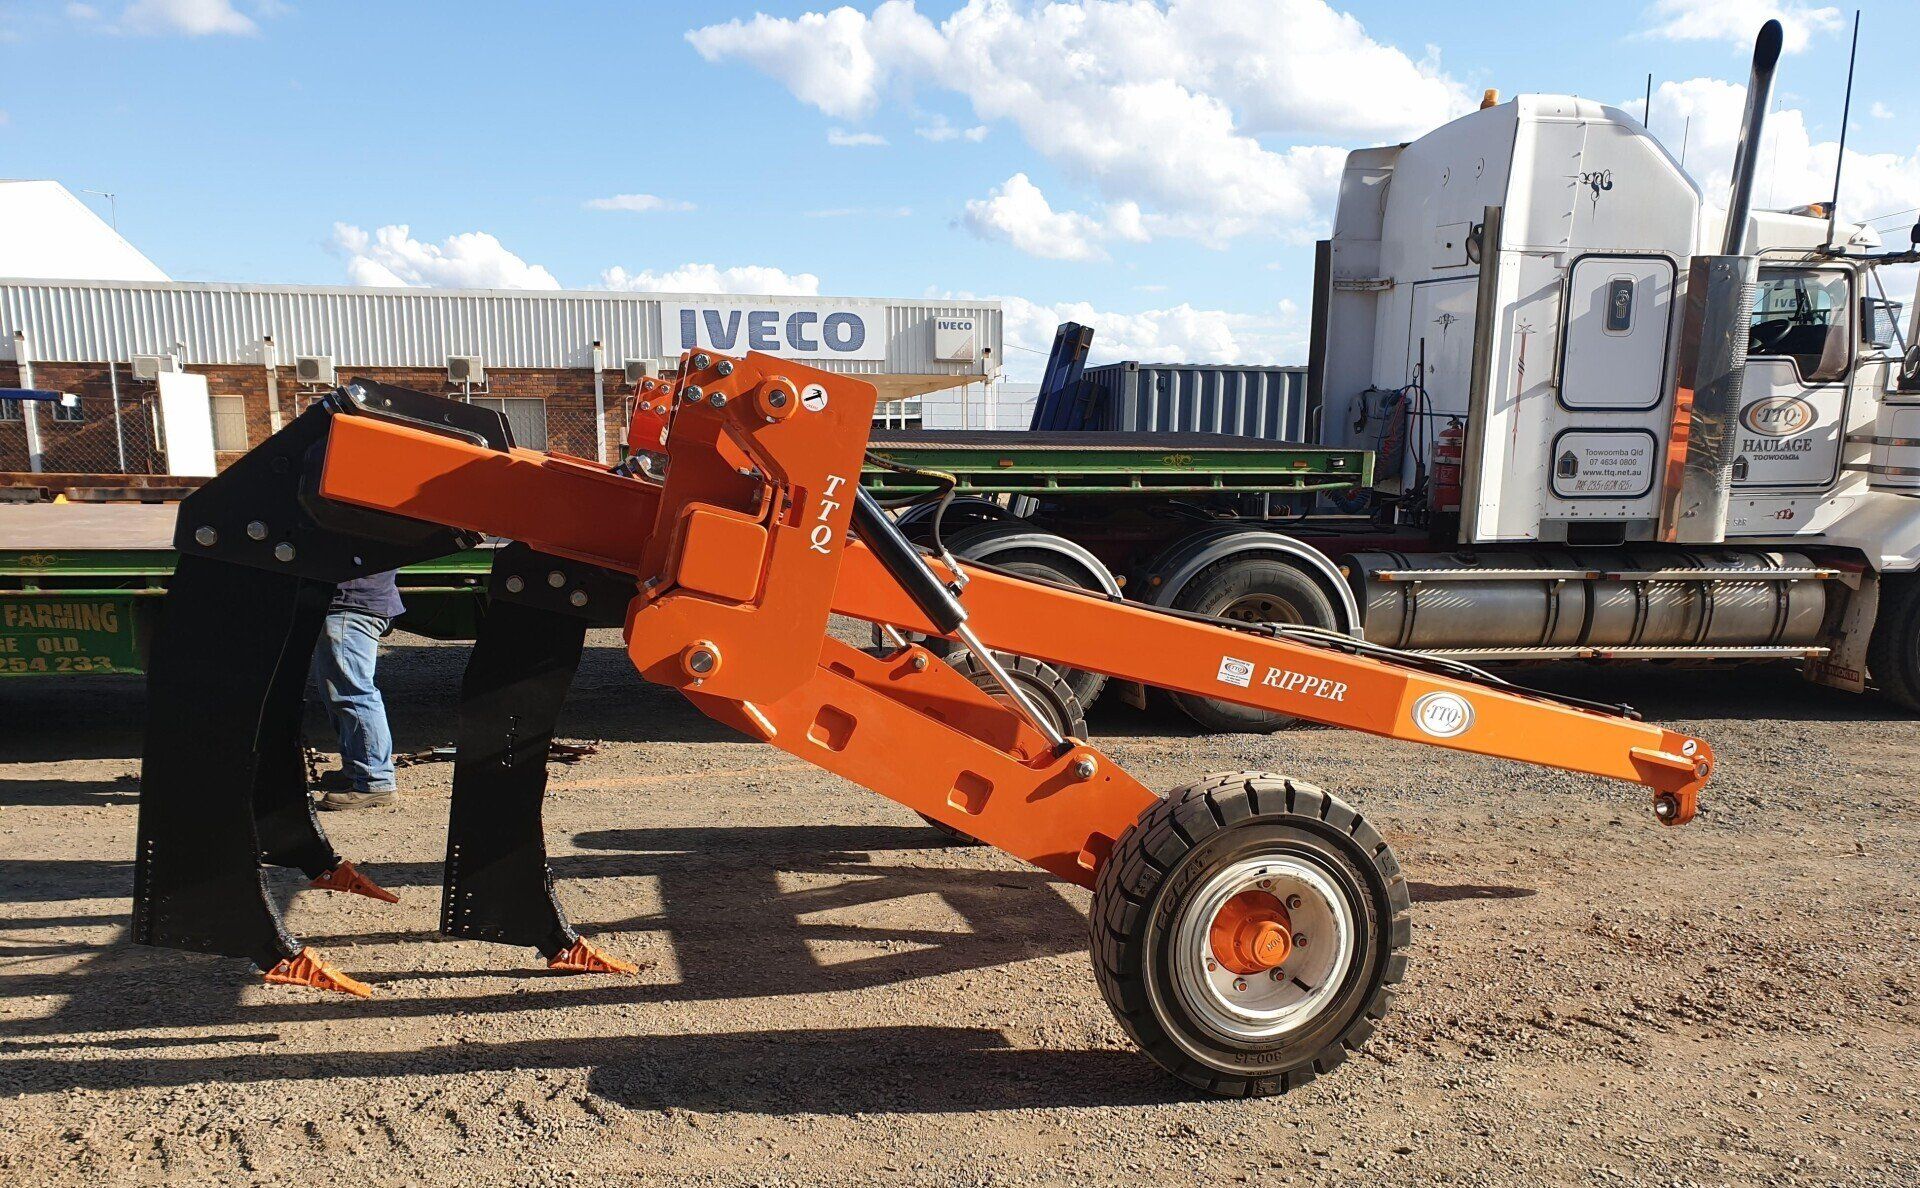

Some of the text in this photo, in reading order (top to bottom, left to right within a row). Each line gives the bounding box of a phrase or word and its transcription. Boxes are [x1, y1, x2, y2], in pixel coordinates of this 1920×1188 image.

[680, 309, 866, 352] IVECO
[938, 321, 973, 330] IVECO
[1762, 408, 1797, 427] TTQ
[1585, 448, 1629, 456] Toowoomba
[1741, 438, 1812, 453] HAULAGE
[1582, 469, 1642, 477] www.ttq.net.au
[810, 474, 847, 554] TTQ
[3, 602, 119, 633] FARMING
[1261, 666, 1349, 702] RIPPER
[1430, 704, 1459, 728] TTQ
